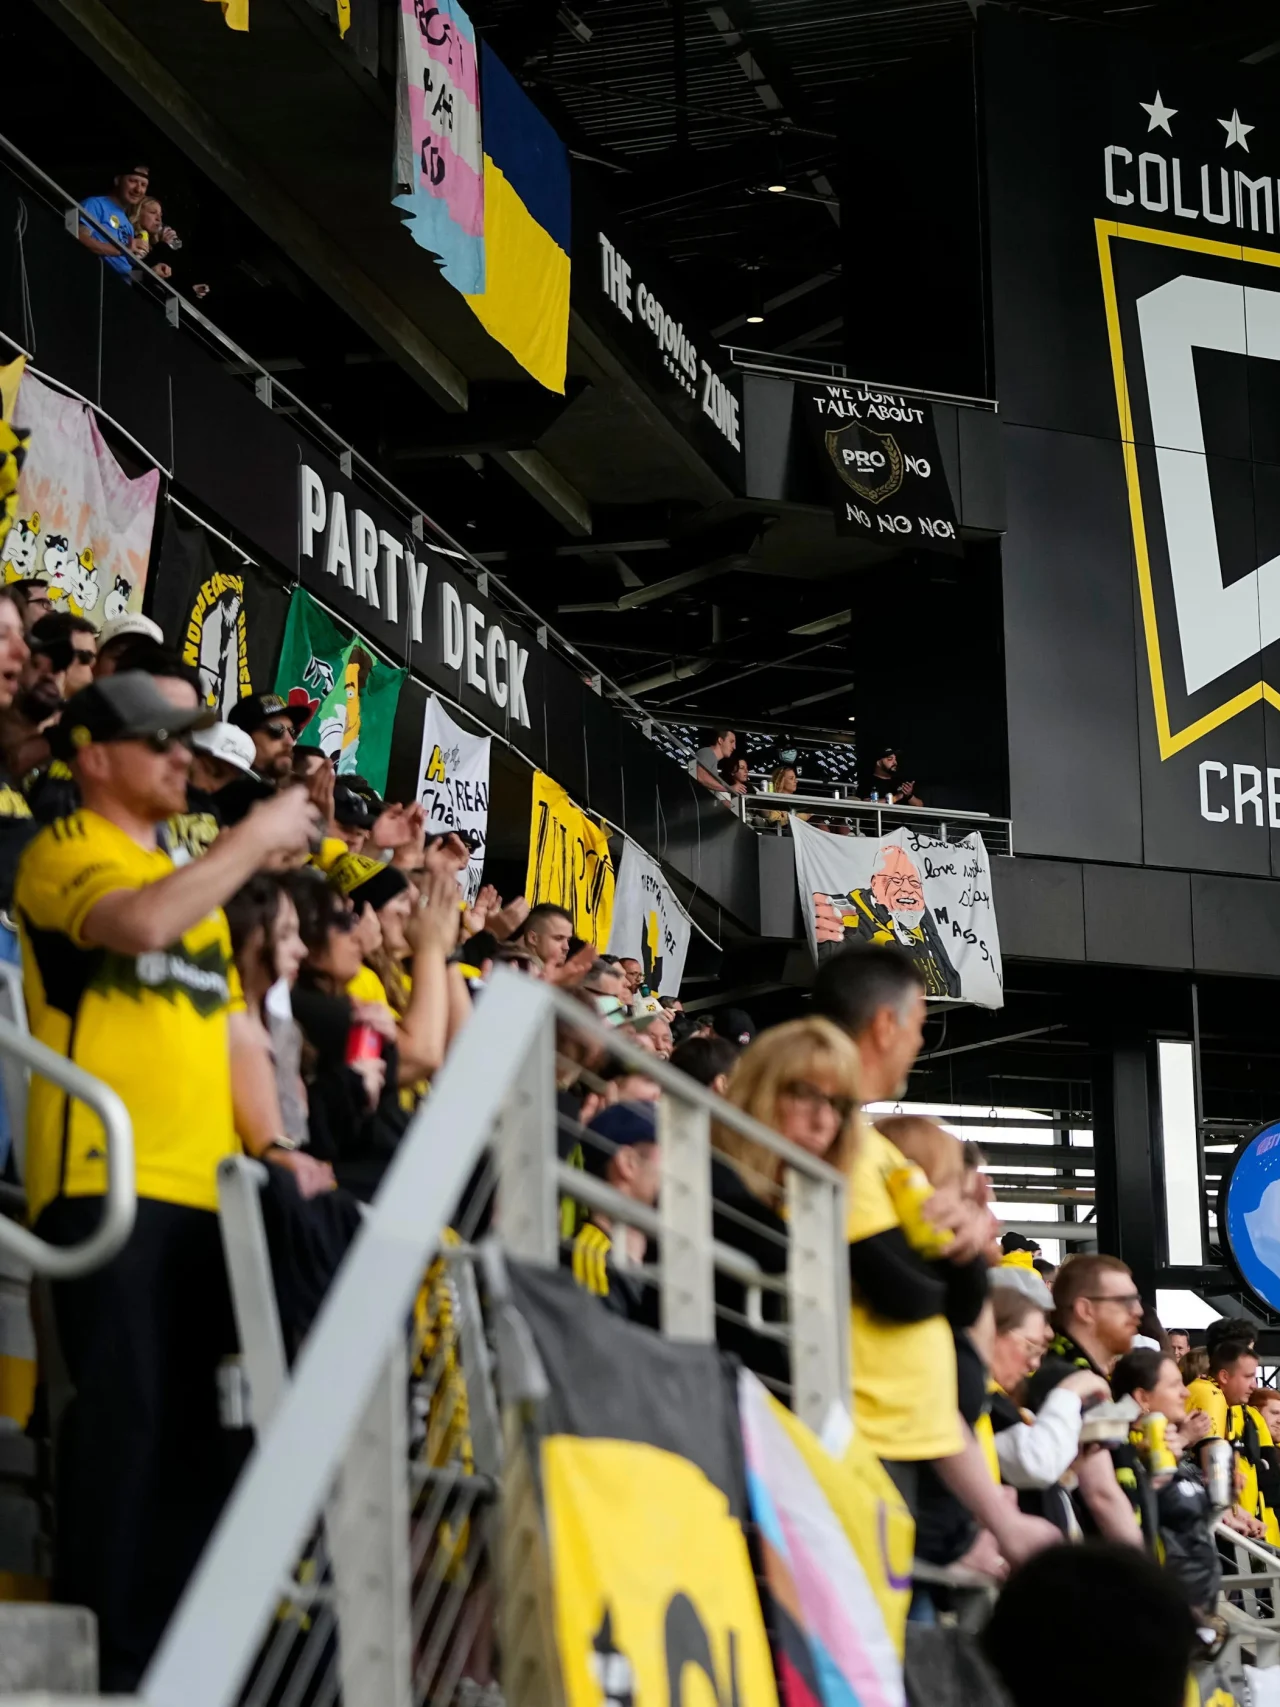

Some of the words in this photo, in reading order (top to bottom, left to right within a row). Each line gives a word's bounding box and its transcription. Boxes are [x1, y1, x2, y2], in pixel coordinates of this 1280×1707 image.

[598, 232, 633, 324] THE
[636, 283, 697, 381] cenovus
[701, 359, 741, 453] ZONE
[826, 386, 853, 400] WE
[813, 397, 862, 418] TALK
[867, 404, 924, 424] ABOUT
[842, 449, 886, 468] PRO
[904, 454, 931, 478] NO
[846, 503, 872, 528] NO
[877, 515, 912, 533] NO
[918, 517, 956, 539] NO!
[301, 464, 428, 644] PARTY
[442, 582, 531, 729] DECK
[924, 857, 957, 879] love
